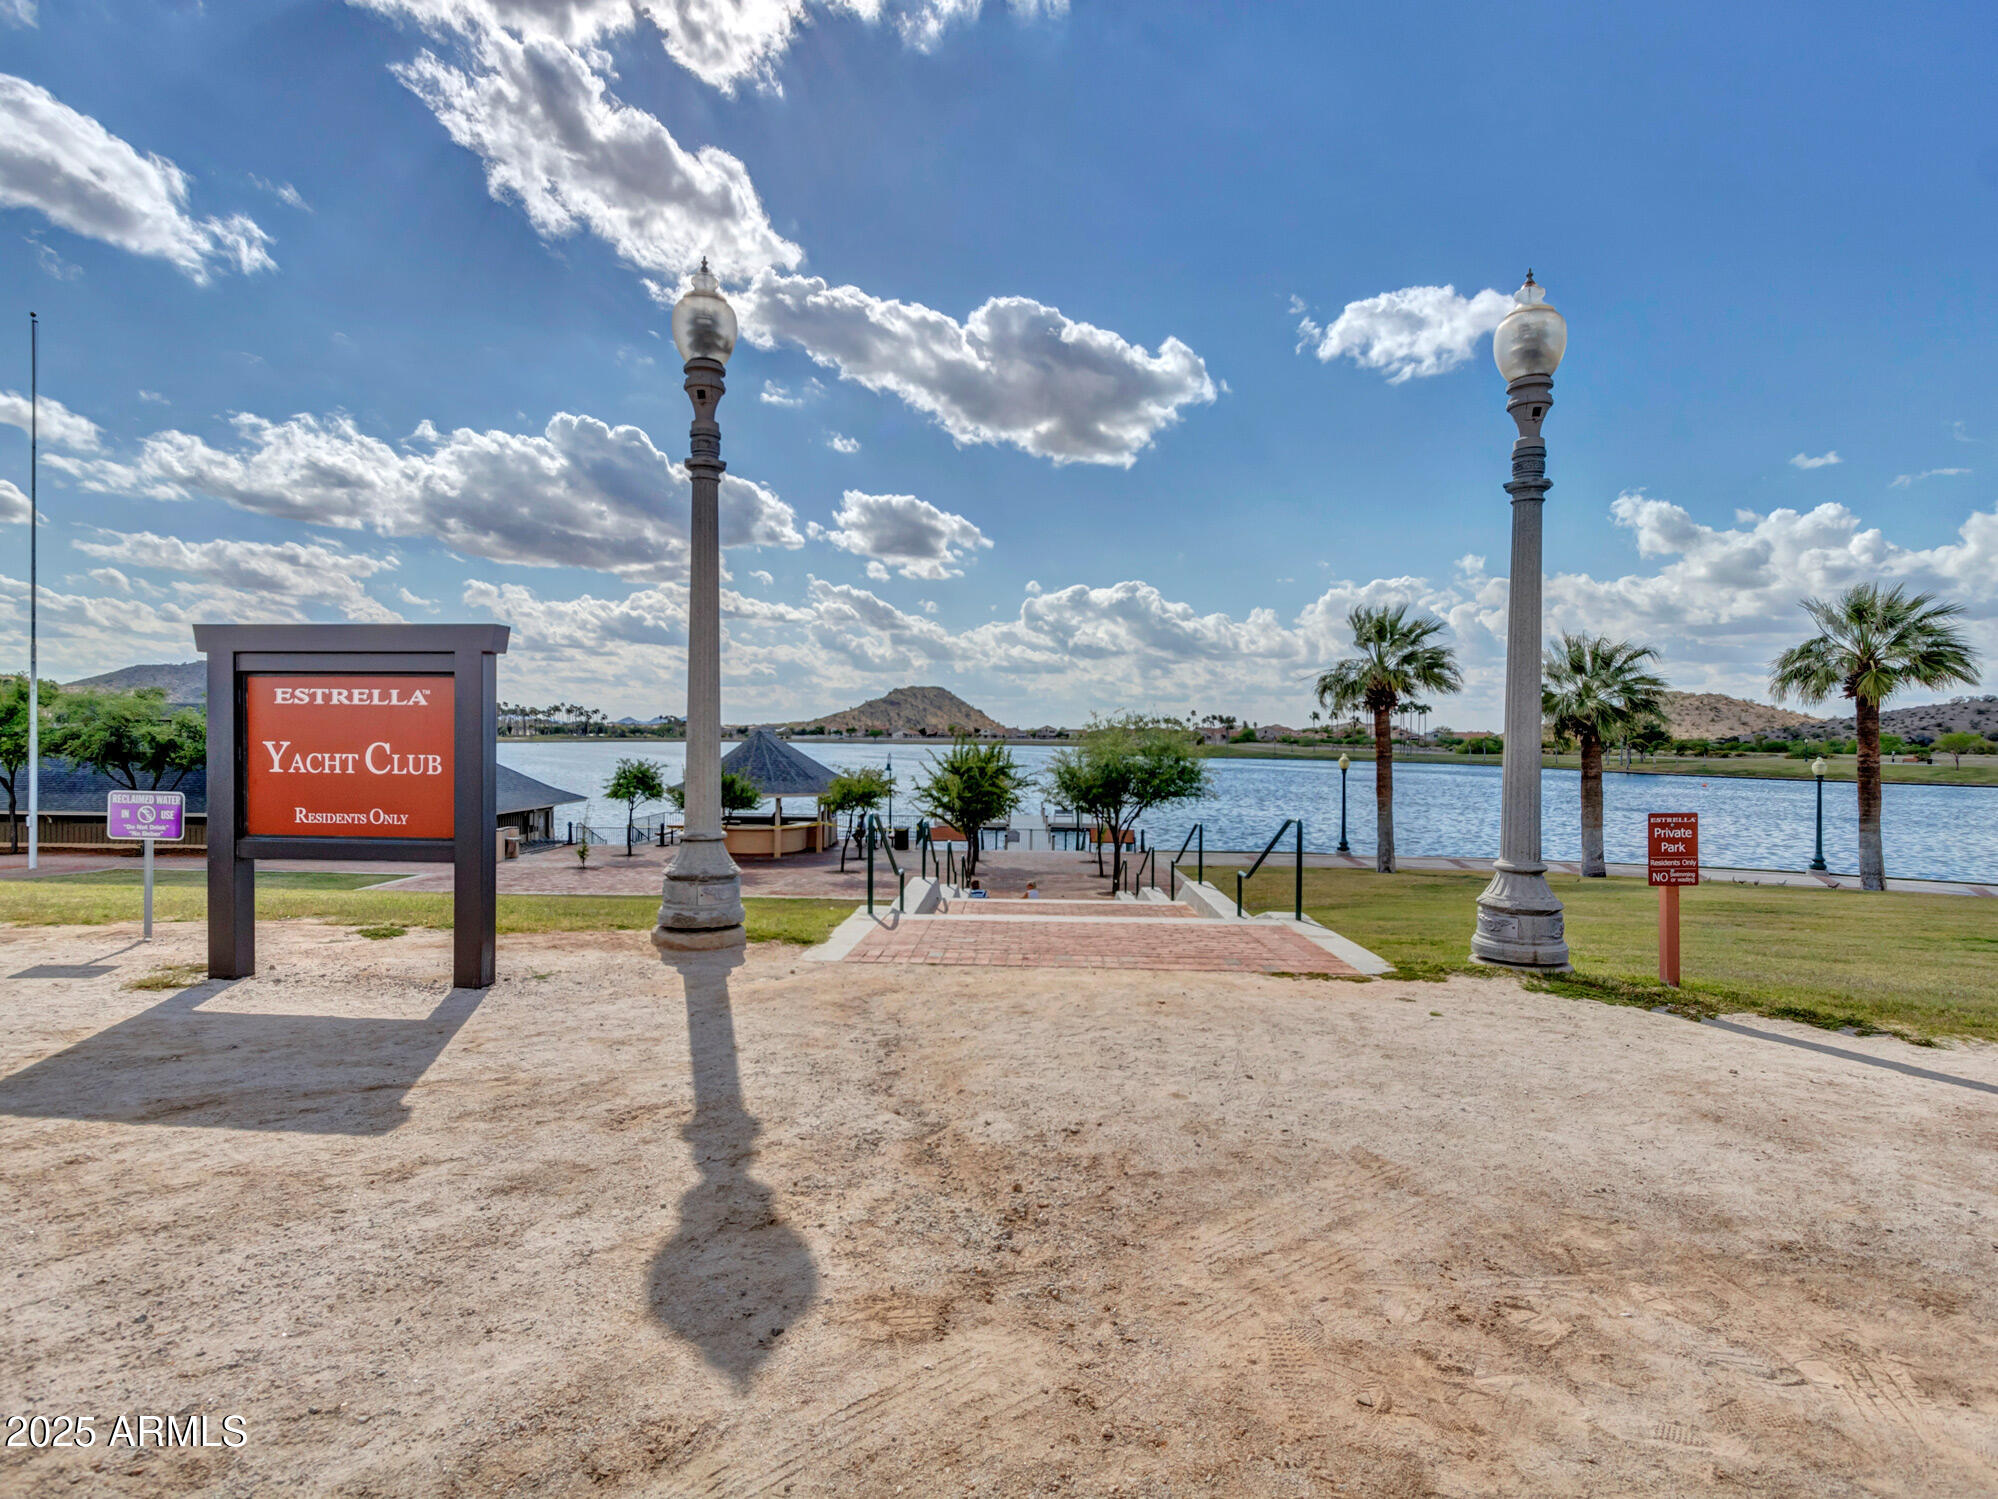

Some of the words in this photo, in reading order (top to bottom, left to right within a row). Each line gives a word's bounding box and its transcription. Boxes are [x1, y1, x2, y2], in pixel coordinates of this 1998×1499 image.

[262, 741, 358, 774] YACHT
[365, 742, 442, 775] CLUB
[112, 794, 154, 804] RECLAIMED
[156, 795, 181, 805] WATER
[121, 809, 129, 818] IN
[160, 810, 175, 820] USE
[294, 807, 367, 824] RESIDENTS
[369, 808, 408, 825] ONLY
[1654, 827, 1693, 838] Private
[1661, 842, 1686, 853] Park
[1652, 872, 1669, 882] NO
